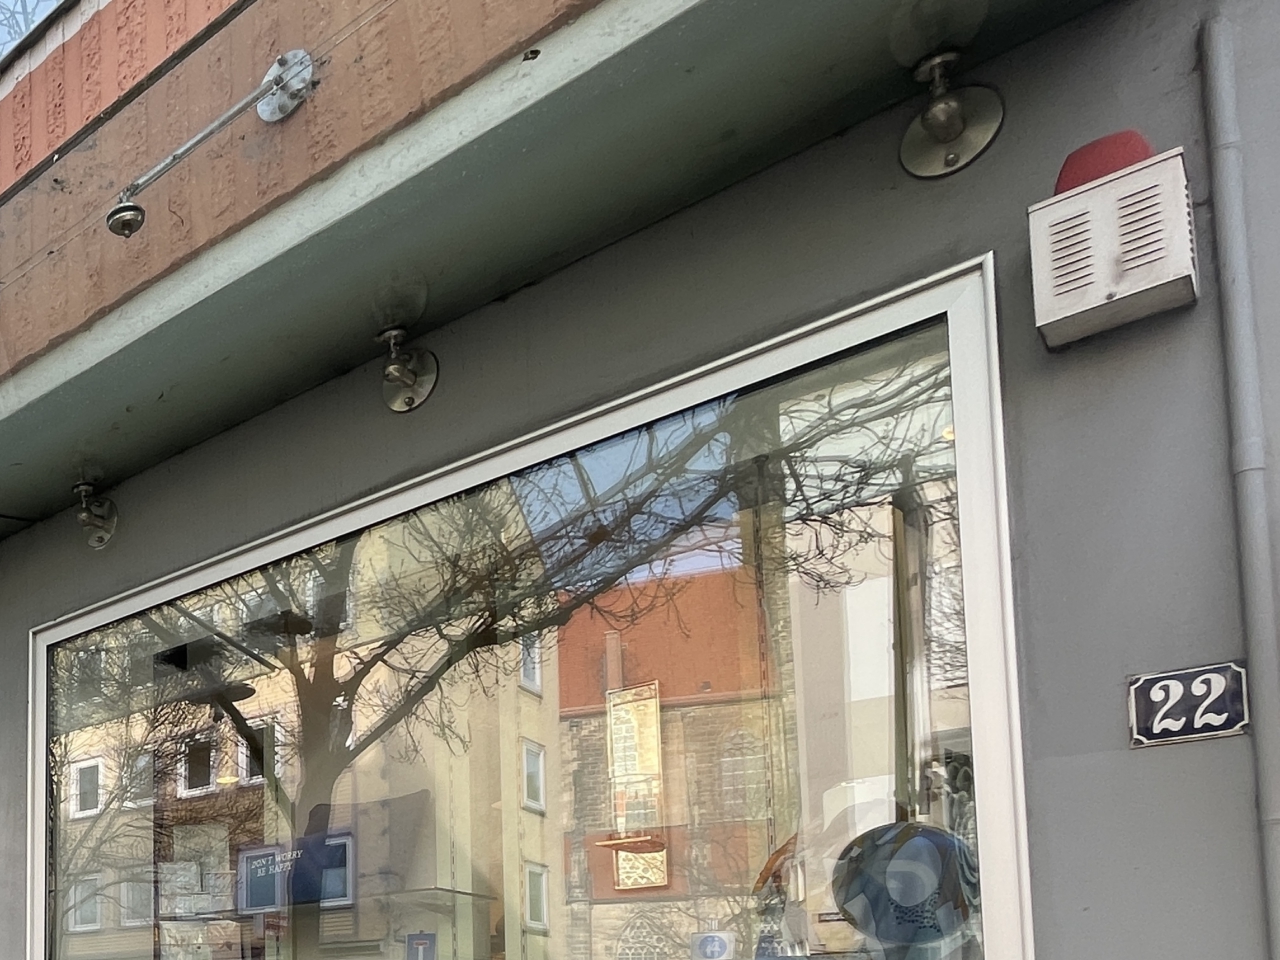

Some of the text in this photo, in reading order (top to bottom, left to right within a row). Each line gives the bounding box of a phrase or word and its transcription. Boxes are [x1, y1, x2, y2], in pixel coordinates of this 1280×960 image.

[1149, 672, 1229, 734] 22
[275, 849, 304, 862] WORRY
[268, 861, 294, 875] HAPPY
